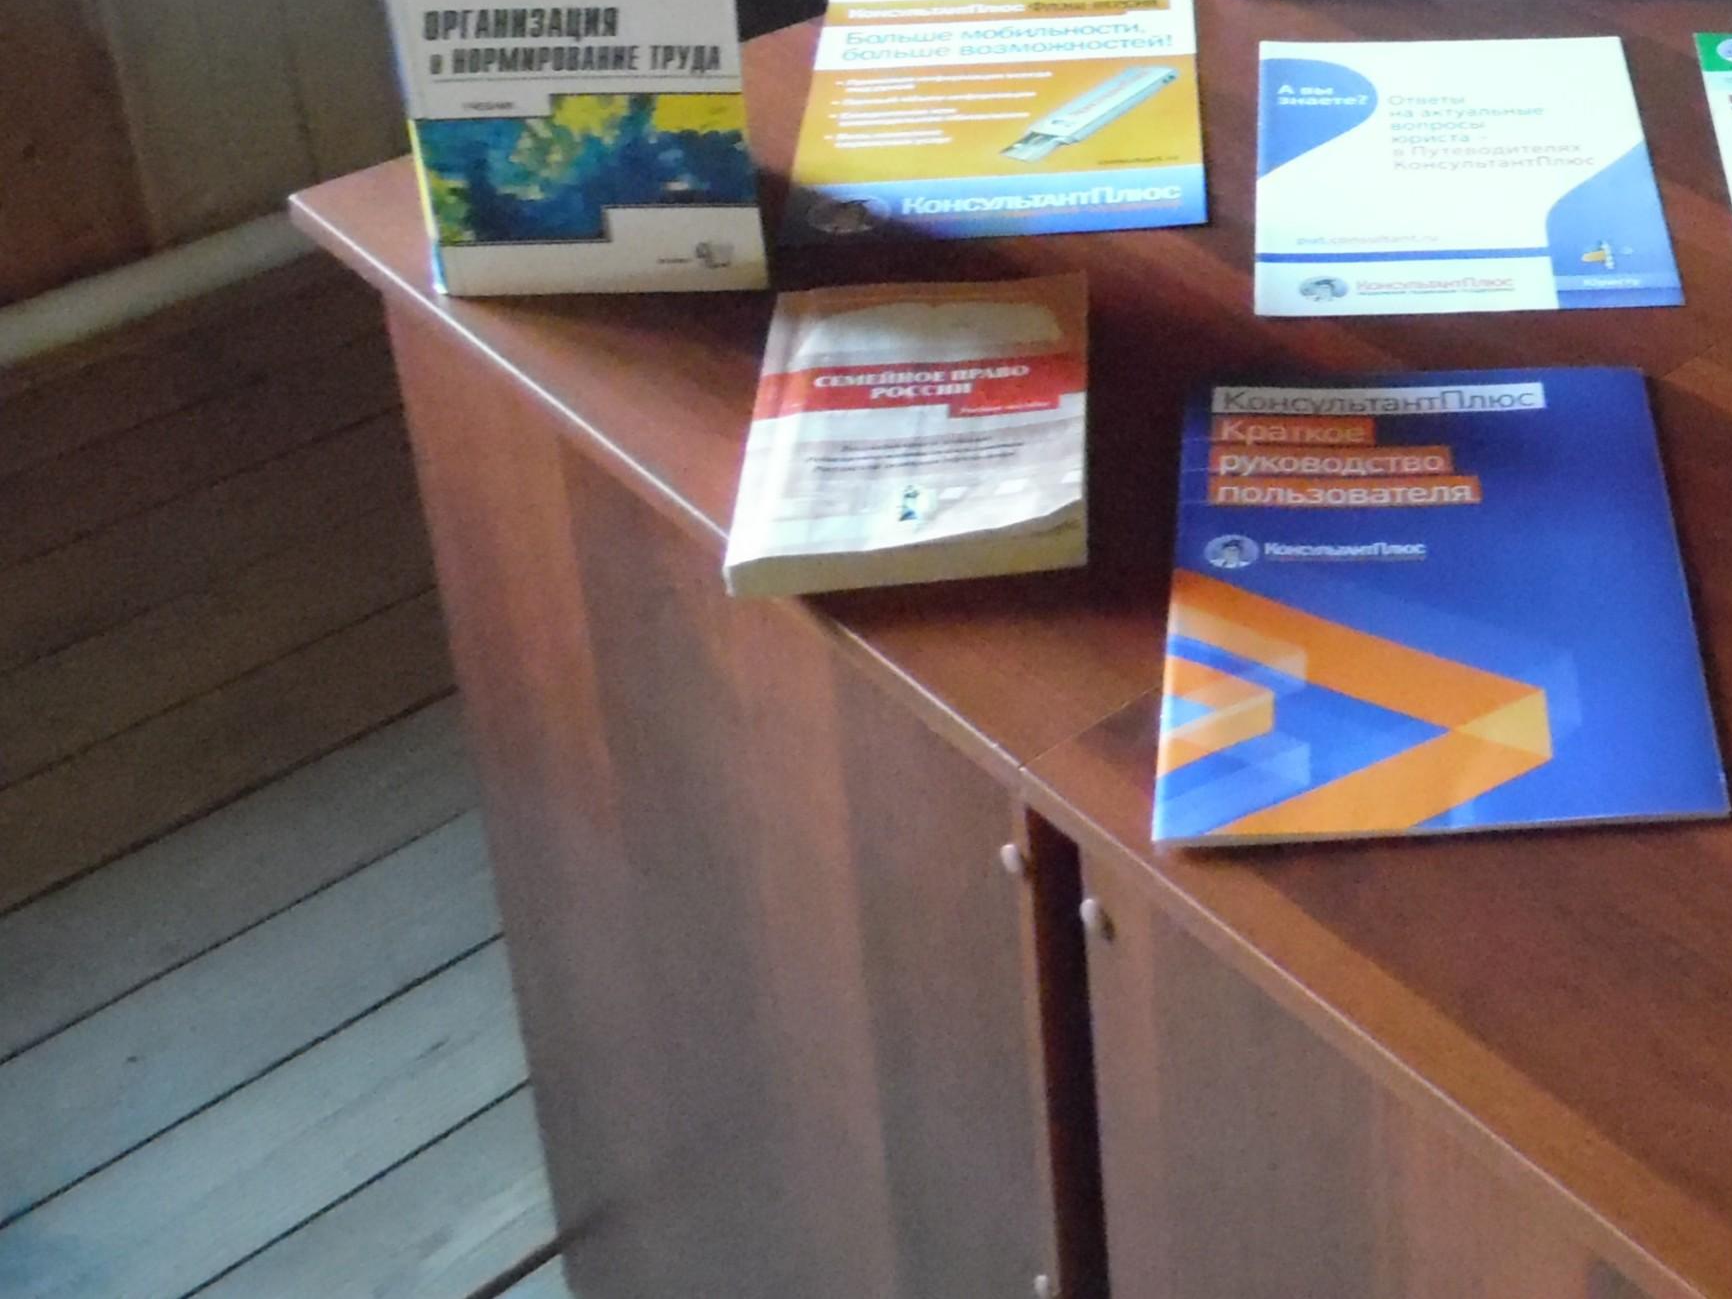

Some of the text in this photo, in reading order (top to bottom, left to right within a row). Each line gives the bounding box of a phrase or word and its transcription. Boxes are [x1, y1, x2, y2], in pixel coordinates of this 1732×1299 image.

[423, 7, 619, 42] ОРГАНИЗАЦИЯ
[842, 34, 1174, 62] больше возможностей!
[847, 30, 952, 46] Больше
[453, 45, 639, 75] НОРМИРОВАНИЕ
[649, 45, 722, 74] ТРУДА
[1277, 94, 1369, 107] знаете?
[1388, 94, 1466, 106] Ответы
[1420, 105, 1545, 120] актуальные
[1390, 120, 1486, 133] вопросы
[1391, 133, 1470, 147] юриста
[1410, 143, 1582, 159] Путеводителях
[814, 364, 1031, 388] СЕМЕЙНОЕ ПРАВО
[869, 382, 973, 400] РОССИИ
[1222, 387, 1537, 414] КонсультантПлюс
[1220, 422, 1366, 446] Краткое
[1217, 452, 1445, 477] руководство
[1217, 481, 1474, 505] пользователя
